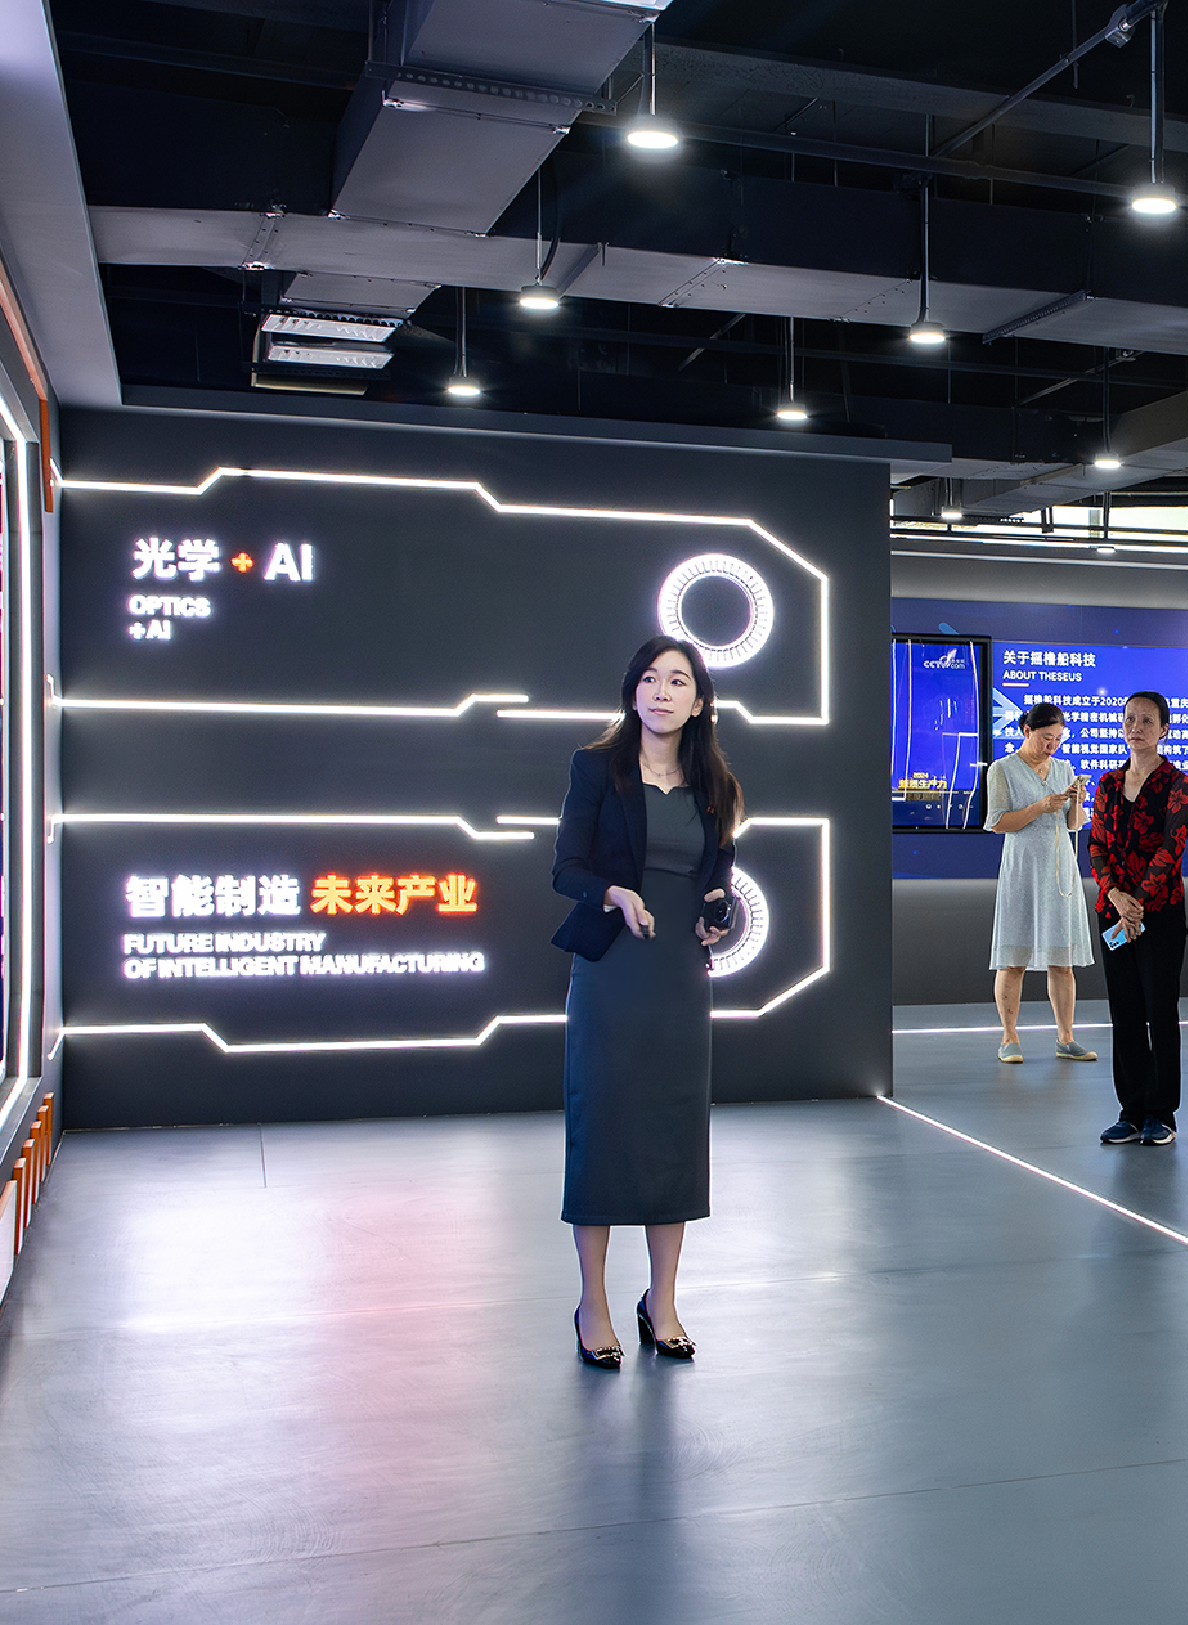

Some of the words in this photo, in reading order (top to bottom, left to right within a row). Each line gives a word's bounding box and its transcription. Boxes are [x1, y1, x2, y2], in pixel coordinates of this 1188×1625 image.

[133, 538, 221, 581] 光学
[264, 543, 314, 581] AI
[128, 595, 212, 617] OPTICS
[1003, 671, 1037, 680] ABOUT
[1038, 672, 1082, 682] THESEUS
[125, 875, 301, 917] 智能制造
[310, 873, 477, 915] 未来产业
[124, 932, 214, 954] FUTURE
[214, 931, 327, 952] INDUSTRY
[124, 957, 157, 978] OF
[157, 955, 299, 977] INTELLIGENT
[300, 952, 485, 975] MANUFACTURING
